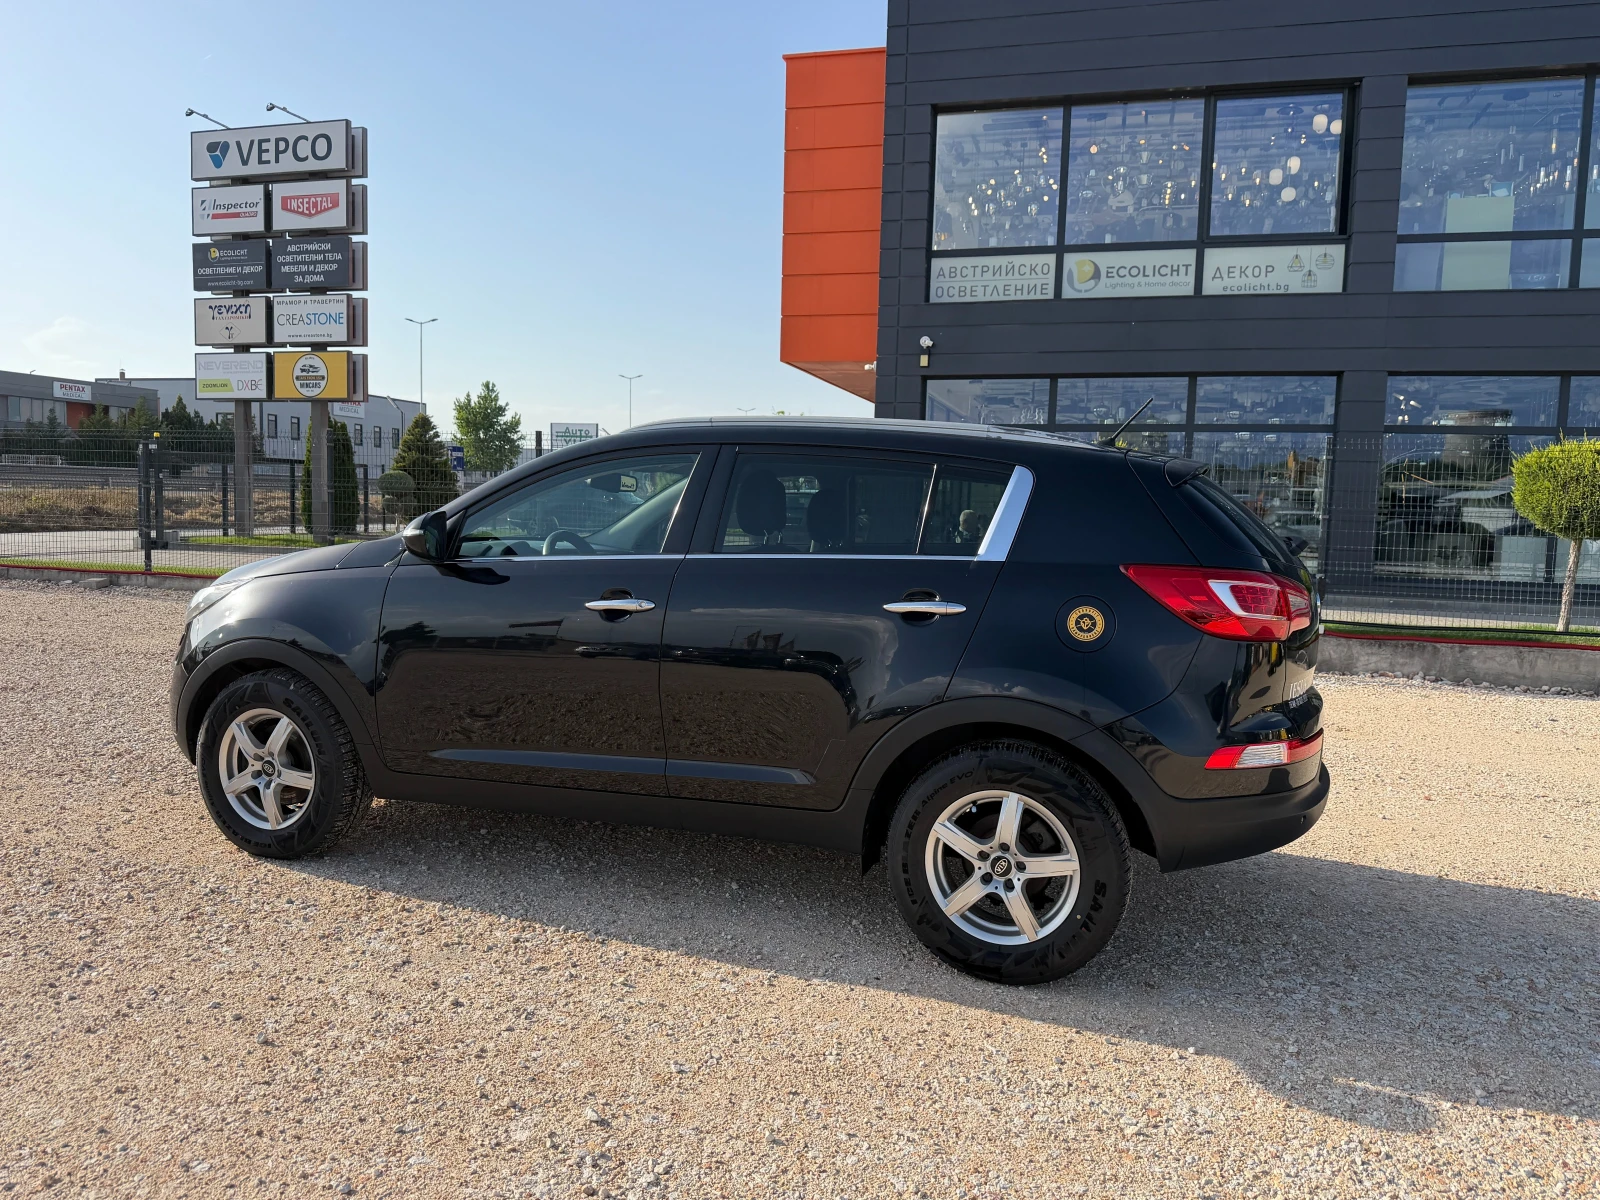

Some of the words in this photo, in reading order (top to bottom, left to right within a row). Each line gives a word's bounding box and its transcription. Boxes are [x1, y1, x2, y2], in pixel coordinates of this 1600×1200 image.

[236, 133, 332, 166] VEPCO
[212, 198, 260, 212] Inspector
[287, 196, 332, 214] INSECTAL
[286, 242, 331, 252] АВСТРИЙСКИ
[276, 254, 324, 262] ОСВЕТИТЕЛНИ
[324, 252, 342, 260] ТЕЛА
[198, 266, 236, 274] ОСВЕТЛЕНИЕ
[242, 266, 263, 274] ДЕКОР
[281, 264, 308, 273] МЕБЕЛИ
[315, 264, 338, 272] ДЕКОР
[936, 261, 1050, 279] АВСТРИЙСКО
[1106, 264, 1192, 279] ECOLICHT
[1212, 264, 1275, 281] ДЕКОР
[304, 274, 324, 283] ДОМА
[935, 283, 1050, 298] ОСВЕТЛЕНИЕ
[1222, 283, 1290, 292] ecolicht.bg
[276, 312, 344, 326] CREASTONE
[198, 360, 264, 370] NEVEREND
[60, 384, 86, 392] PENTAX
[921, 782, 948, 808] Alpine
